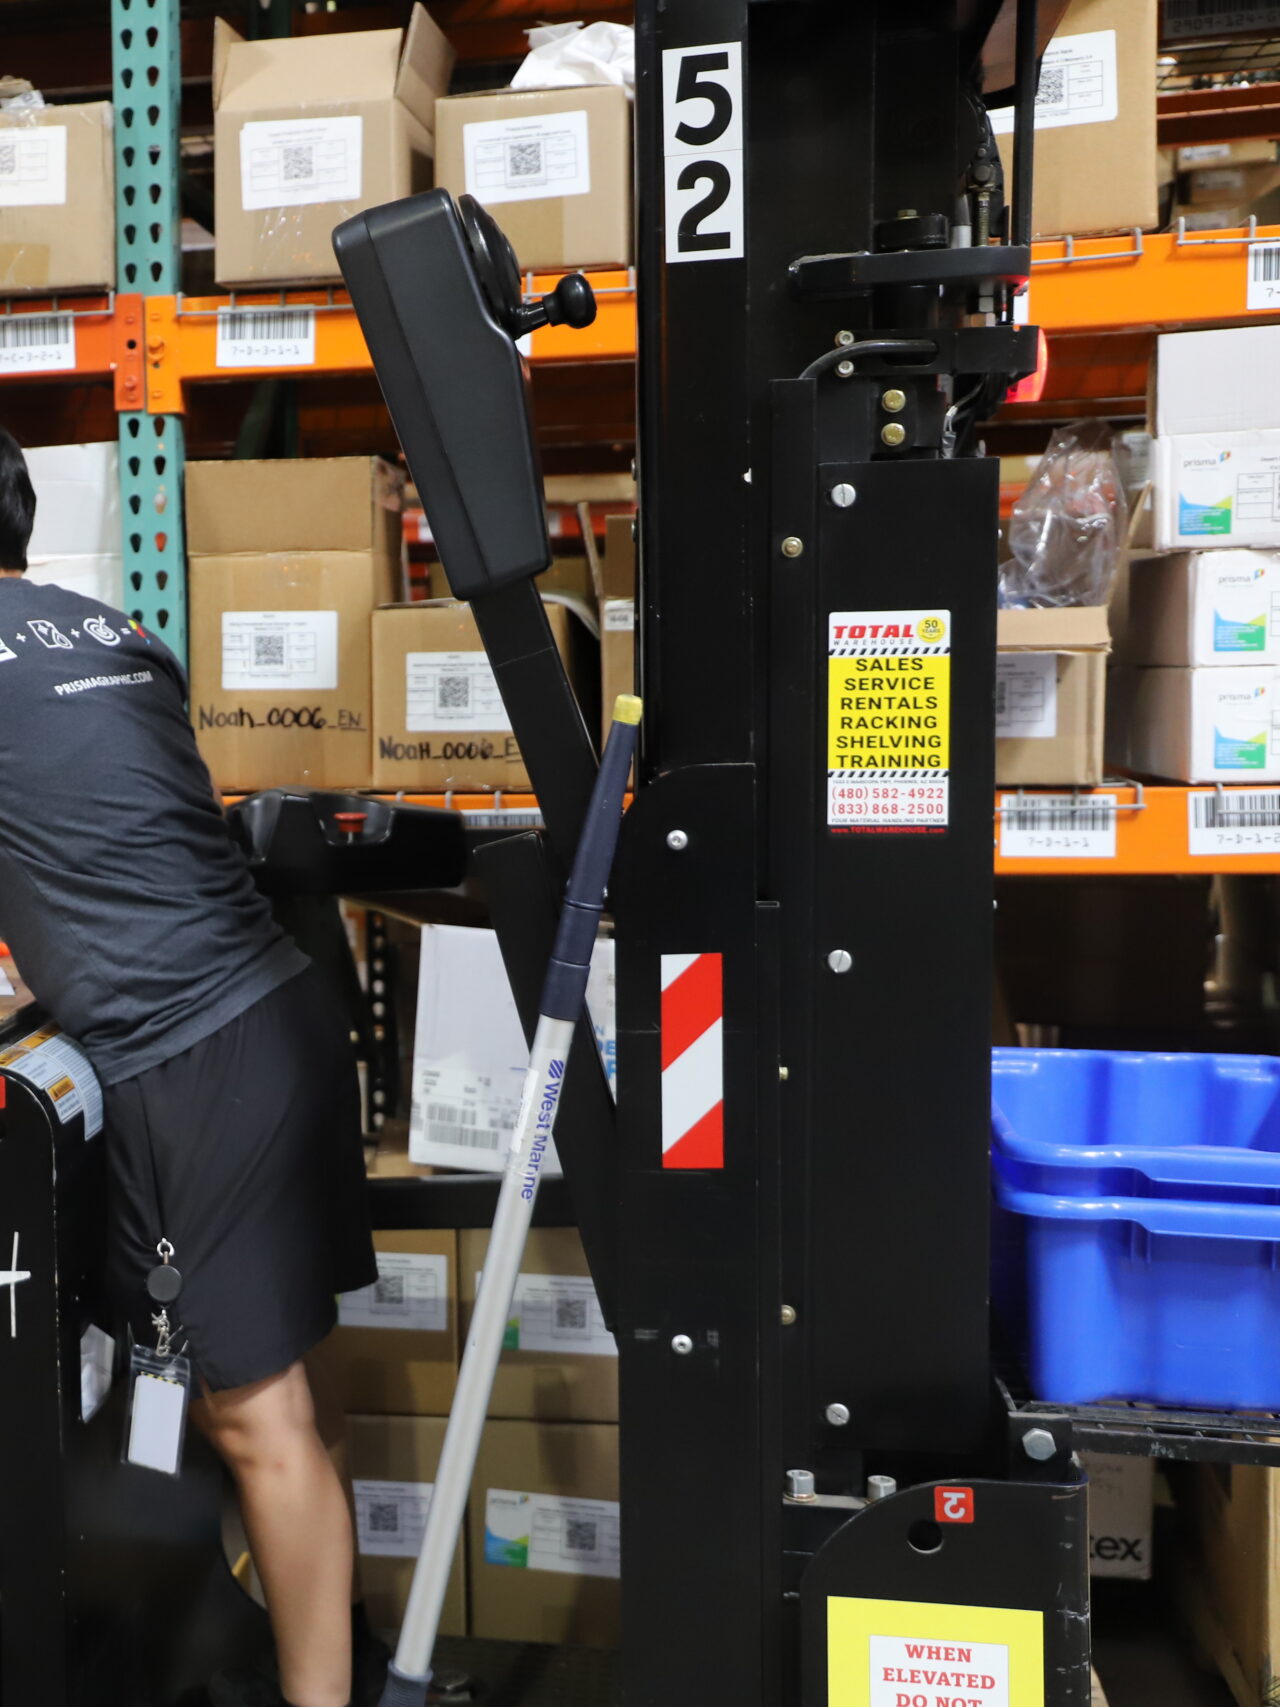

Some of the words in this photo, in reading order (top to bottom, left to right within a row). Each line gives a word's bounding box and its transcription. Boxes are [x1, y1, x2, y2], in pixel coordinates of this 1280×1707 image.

[1183, 458, 1217, 468] prisma
[925, 619, 938, 628] 50
[833, 624, 914, 639] TOTAL
[856, 658, 924, 671] SALES
[54, 671, 154, 696] PRISMAGRAPHIC.COM
[844, 677, 935, 691] SERVICE
[841, 696, 938, 710] RENTALS
[841, 716, 937, 729] RACKING
[836, 735, 942, 749] SHELVING
[836, 754, 942, 768] TRAINING
[832, 787, 868, 800] (480)
[872, 788, 945, 799] 582-4922
[832, 802, 868, 815] (833)
[872, 803, 945, 814] 868-2500
[536, 1082, 560, 1129] West
[520, 1135, 548, 1200] Marine
[1089, 1533, 1142, 1562] ex
[905, 1644, 972, 1663] WHEN
[882, 1667, 996, 1690] ELEVATED
[896, 1693, 928, 1707] DO
